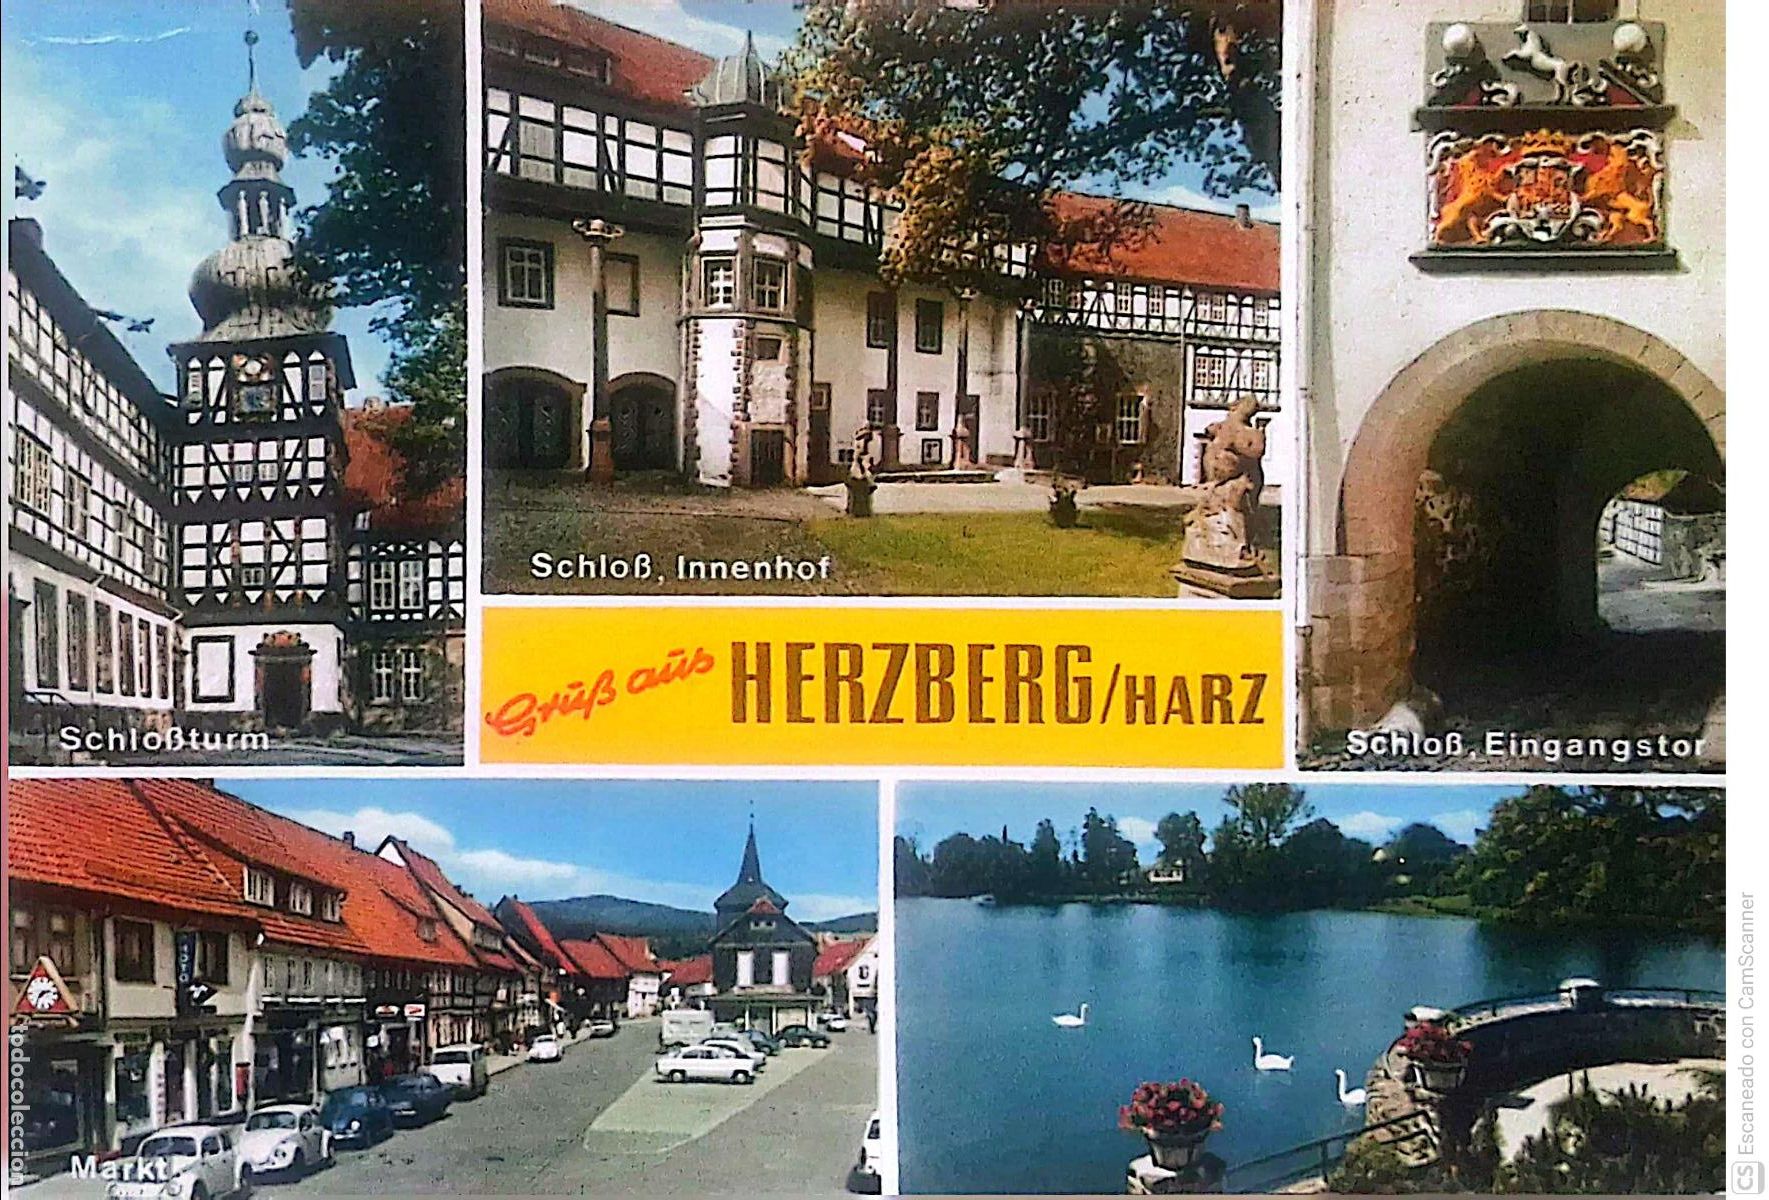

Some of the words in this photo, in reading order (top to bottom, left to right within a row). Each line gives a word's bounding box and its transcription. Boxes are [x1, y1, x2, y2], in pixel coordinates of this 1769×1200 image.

[529, 552, 666, 586] Schloß,
[676, 554, 831, 580] Innenhof
[59, 726, 270, 751] Schloßturm
[1346, 729, 1477, 760] Schloß,
[1485, 730, 1705, 762] Eingangstor
[70, 1154, 168, 1181] Markt
